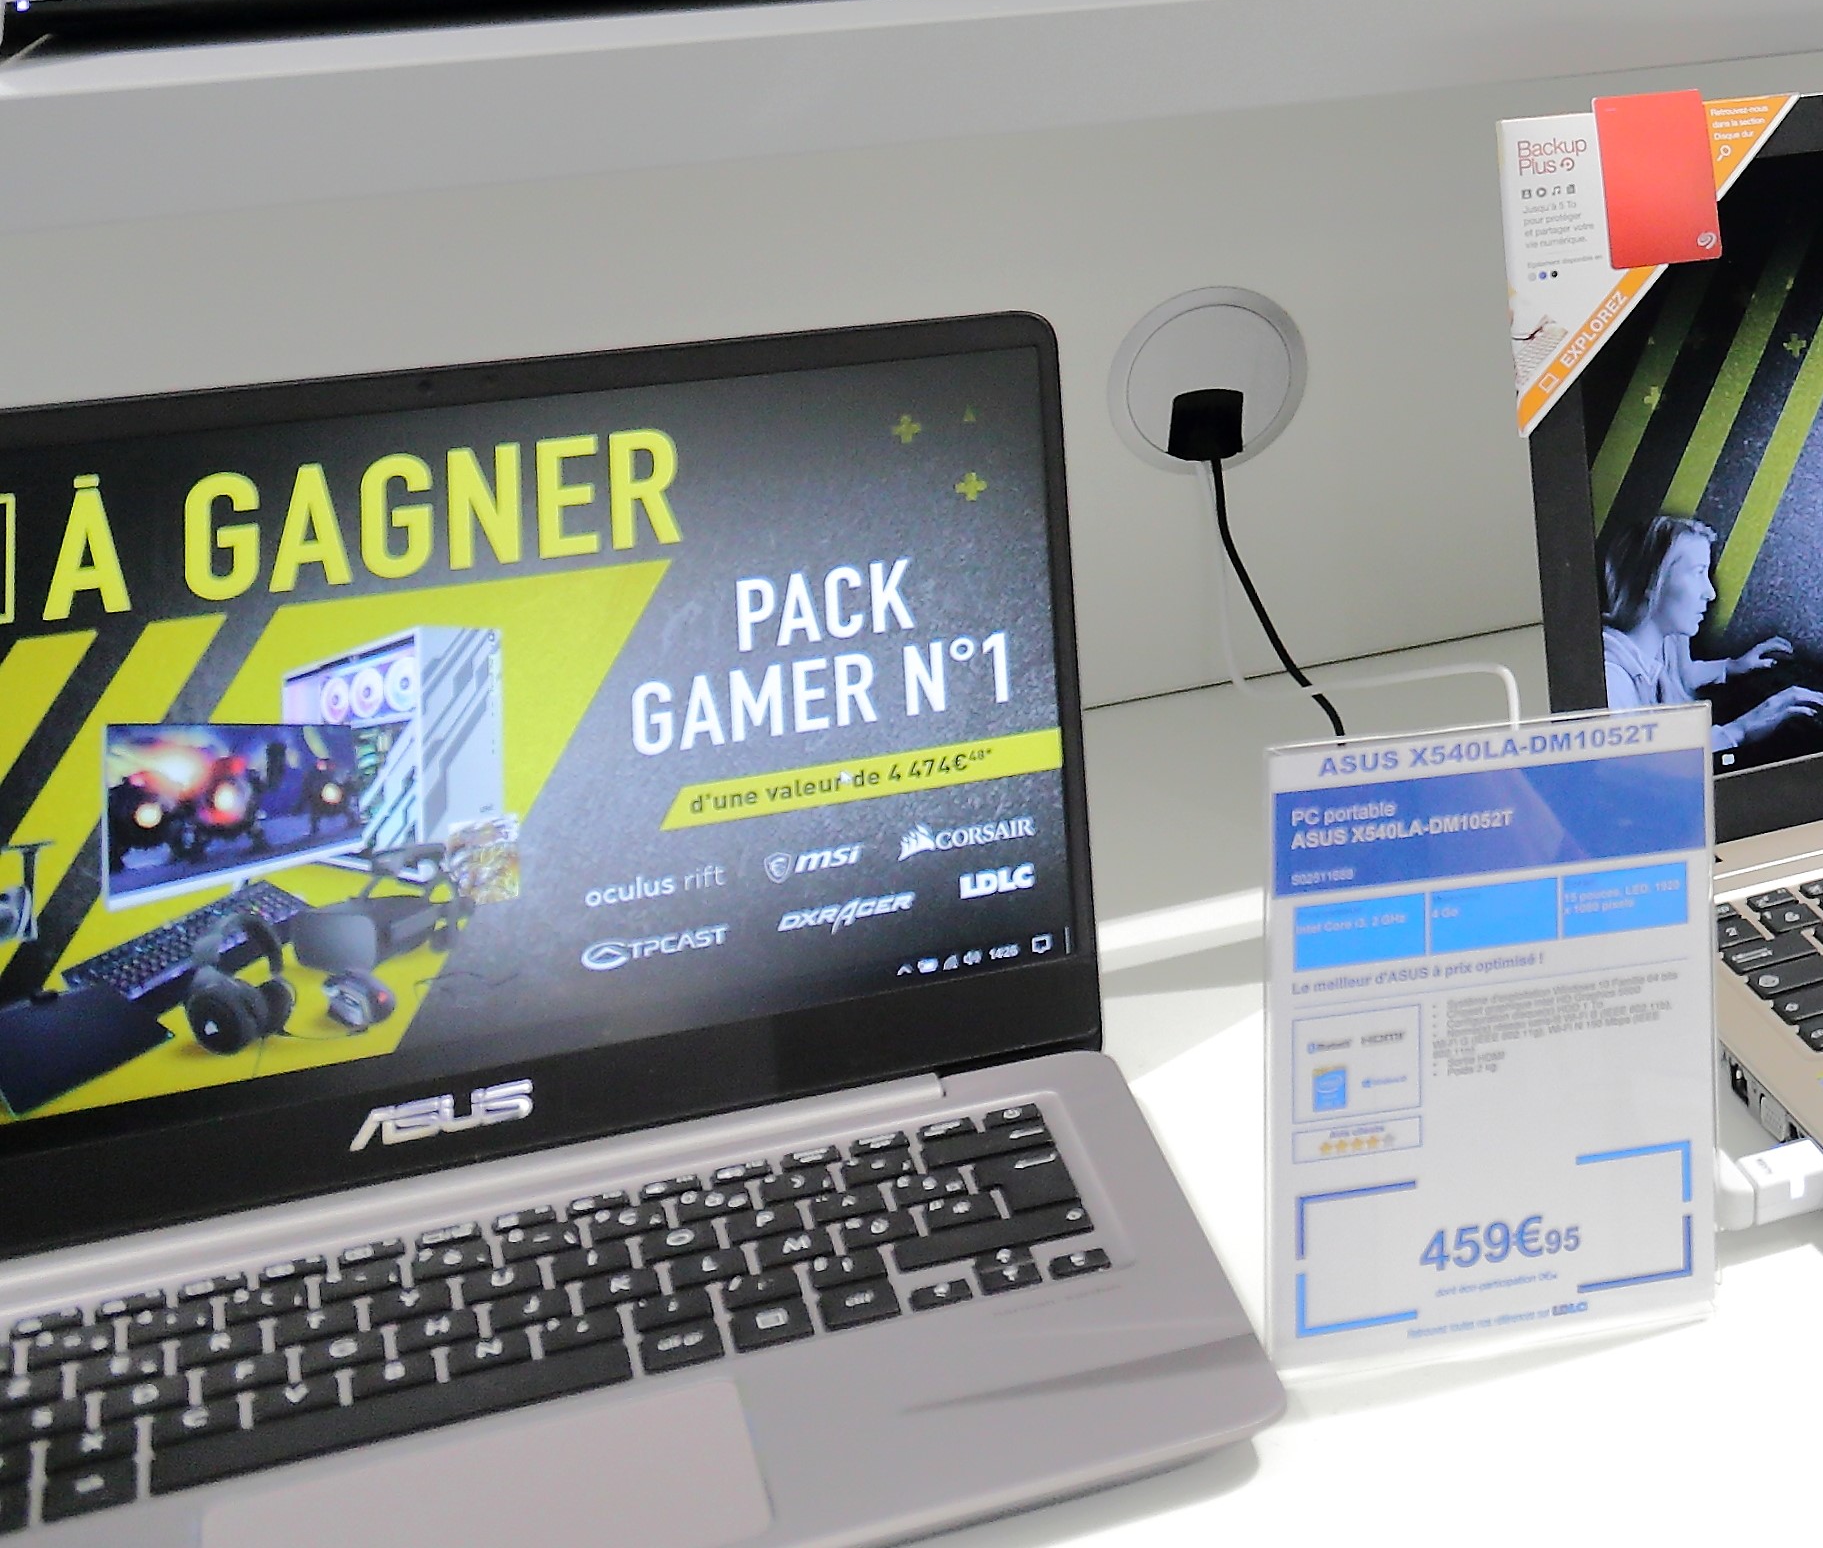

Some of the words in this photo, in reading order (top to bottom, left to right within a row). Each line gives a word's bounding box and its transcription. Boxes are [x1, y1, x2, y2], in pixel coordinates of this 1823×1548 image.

[1517, 138, 1587, 160] Backup
[1518, 156, 1557, 176] Plus
[1559, 291, 1628, 367] EXPLOREZ
[43, 473, 132, 621] À
[184, 426, 683, 601] GAGNER
[735, 556, 916, 653] PACK
[630, 652, 878, 756] GAMER
[904, 630, 1010, 718] N°1
[1318, 749, 1400, 778] ASUS
[1409, 722, 1659, 768] X540LA-DM1052T
[690, 780, 758, 815] d'une
[766, 774, 843, 802] valeur
[852, 765, 880, 788] de
[935, 815, 1036, 852] CORSAIR
[1290, 808, 1320, 827] PC
[1323, 800, 1396, 826] portable
[794, 842, 865, 875] msi
[1290, 827, 1347, 850] ASUS
[585, 876, 675, 908] oculus
[682, 864, 727, 888] rift
[958, 862, 1035, 901] LDLC
[777, 891, 916, 935] DXRACER
[626, 924, 729, 961] TPCAST
[1292, 982, 1310, 995] Le
[1314, 976, 1371, 993] meilleur
[1375, 967, 1428, 985] d'ASUS
[1432, 965, 1442, 978] à
[1445, 962, 1473, 980] prix
[1476, 954, 1536, 977] optimisé
[350, 1079, 535, 1152] ASUS
[1420, 1215, 1581, 1272] 459€95
